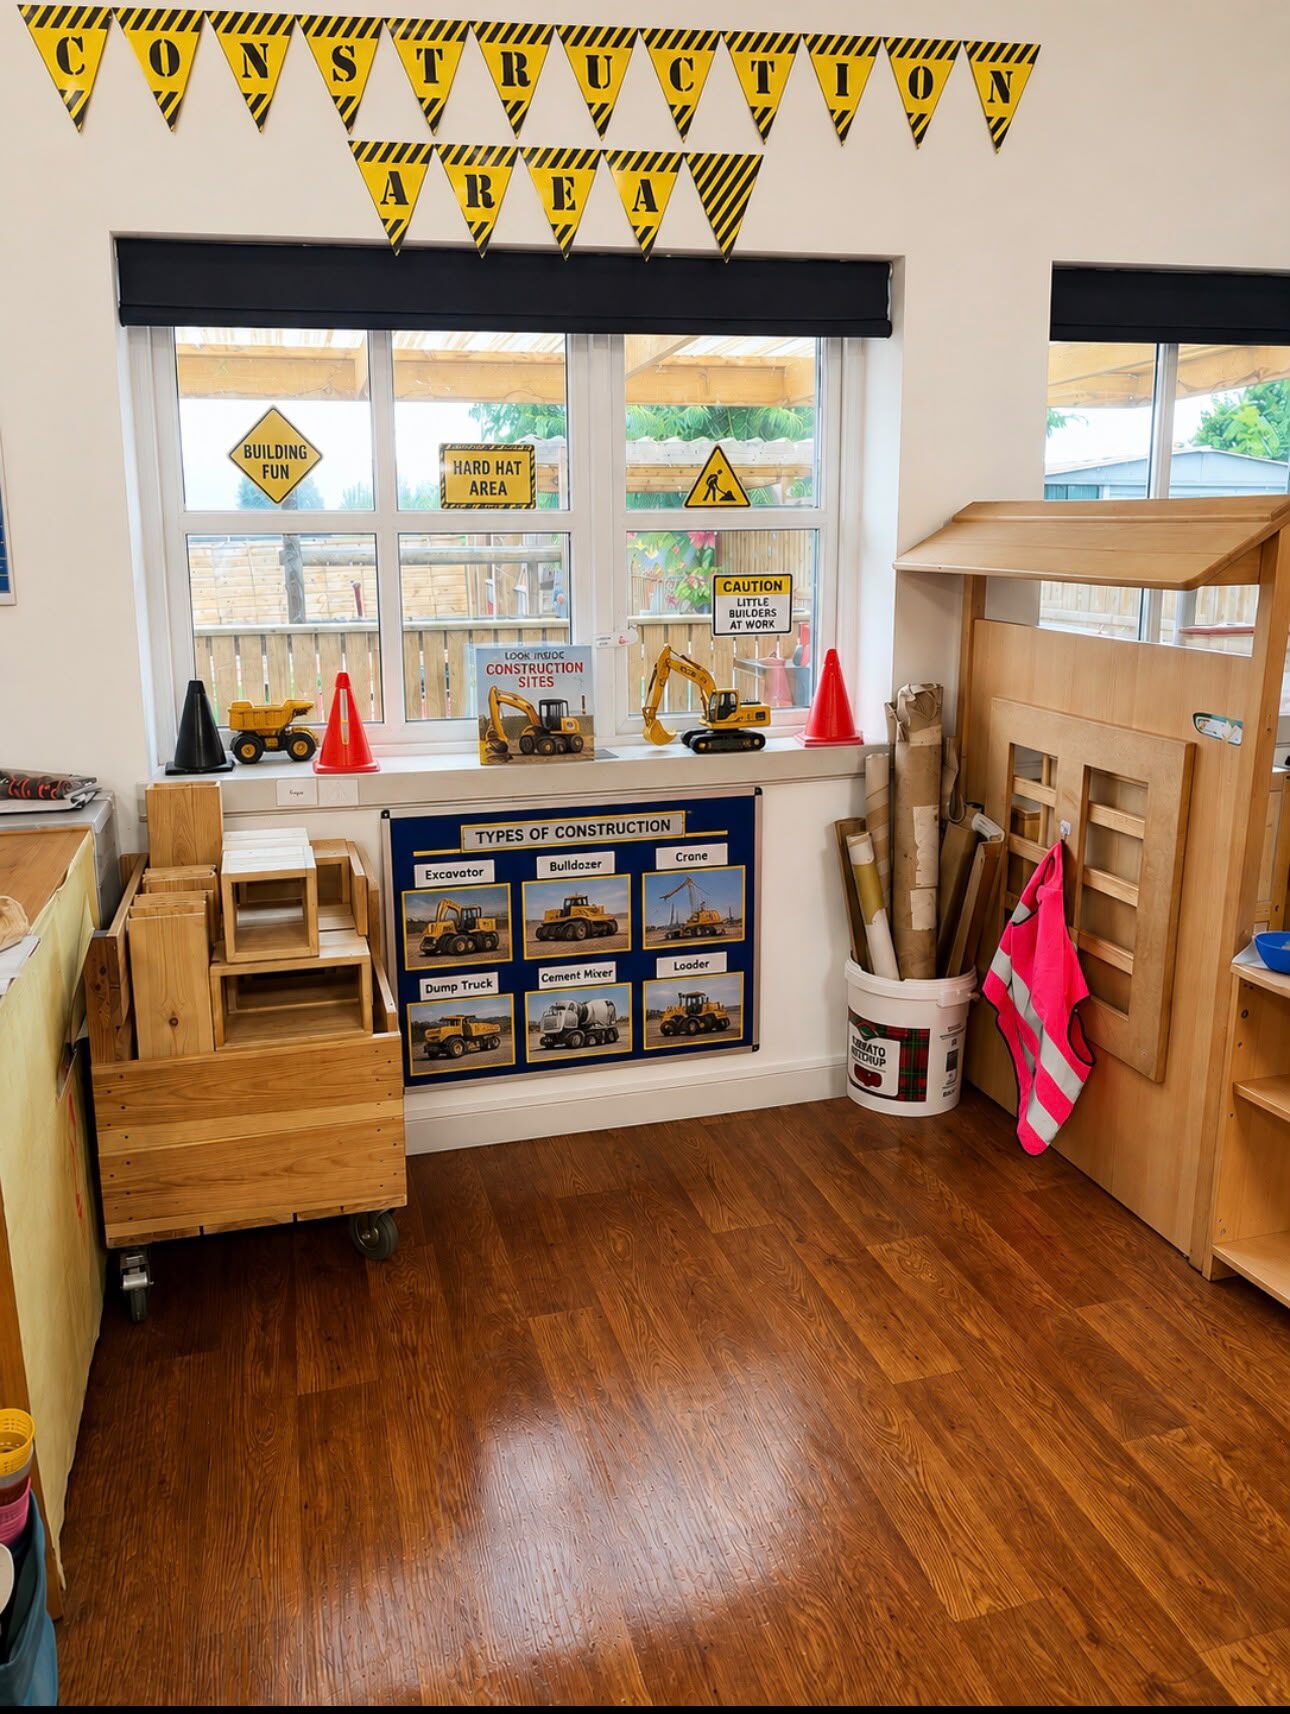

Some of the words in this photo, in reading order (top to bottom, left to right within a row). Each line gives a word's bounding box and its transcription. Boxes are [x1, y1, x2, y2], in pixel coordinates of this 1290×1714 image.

[55, 36, 1014, 104] CONSTRUCTION
[379, 170, 659, 213] AREA
[243, 444, 308, 460] BUILDING
[262, 464, 290, 480] FUN
[452, 460, 491, 475] HARD
[495, 460, 523, 475] HAT
[469, 480, 508, 496] AREA
[723, 580, 783, 592] CAUTION
[737, 597, 769, 607] LITTLE
[729, 608, 777, 618] BUILDERS
[730, 620, 742, 630] AT
[745, 619, 775, 630] WORK
[504, 651, 531, 661] LOOK
[486, 661, 584, 675] CONSTRUCTION
[518, 676, 555, 688] SITES
[475, 829, 524, 844] TYPES
[529, 827, 549, 840] OF
[555, 819, 671, 839] CONSTRUCTION
[676, 852, 708, 862] Crane
[550, 860, 602, 872] Bulldozer
[425, 868, 485, 880] Excavator
[673, 959, 710, 971] Loader
[541, 972, 581, 983] Cement
[583, 969, 613, 979] Mixer
[425, 984, 458, 994] Dump
[461, 978, 493, 990] Truck
